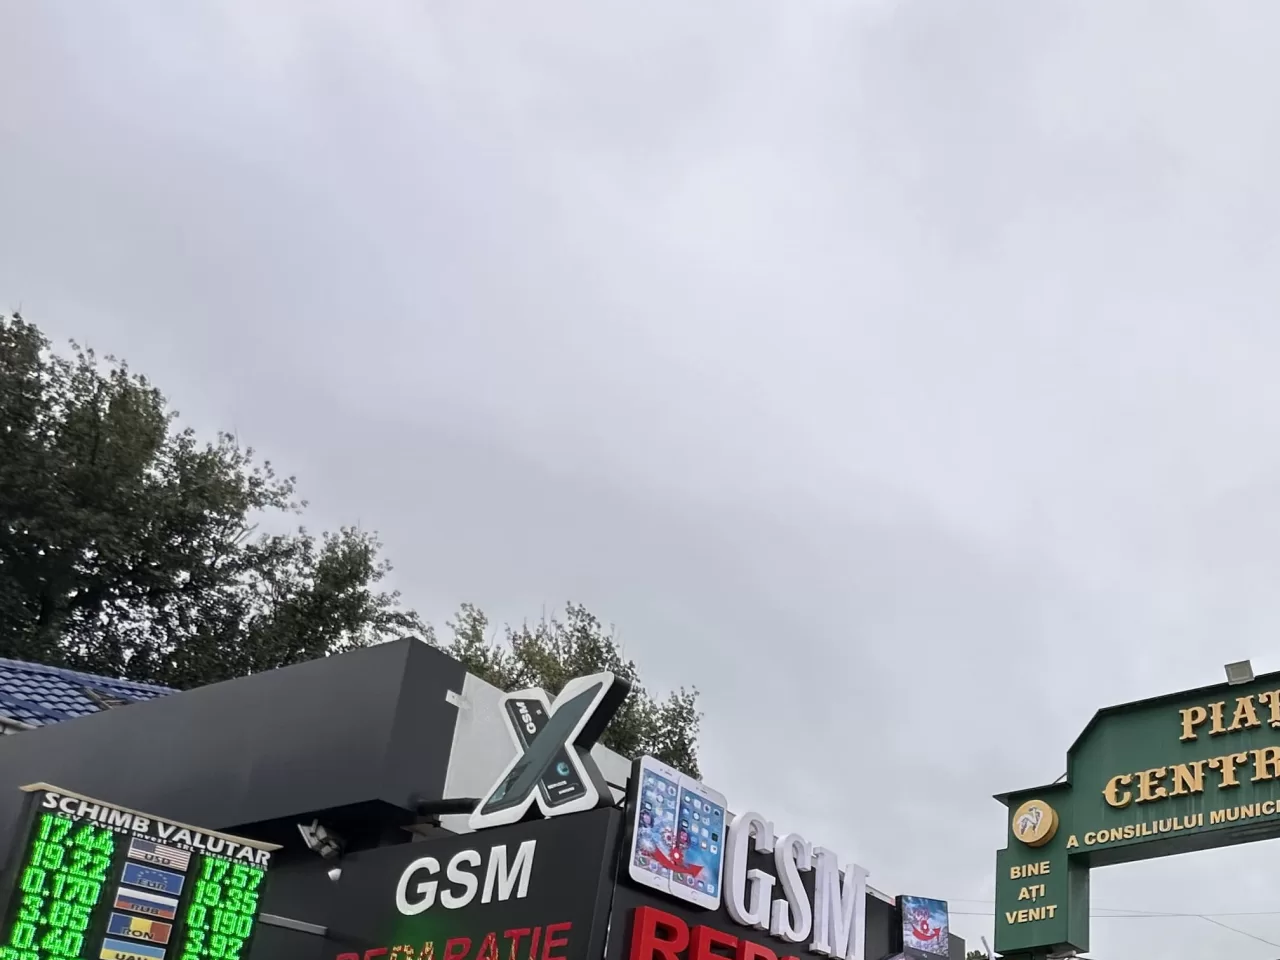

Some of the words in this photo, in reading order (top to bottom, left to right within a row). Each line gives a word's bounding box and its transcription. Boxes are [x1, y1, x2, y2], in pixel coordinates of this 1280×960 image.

[516, 702, 537, 734] GSM
[42, 791, 151, 833] SCHIMB
[156, 821, 272, 866] VALUTAR
[176, 842, 196, 853] SRL
[1066, 834, 1079, 849] A
[1084, 812, 1205, 847] CONSILIULUI
[38, 813, 115, 856] 17.44
[144, 853, 171, 865] USD
[202, 856, 265, 890] 17.57
[1010, 861, 1050, 880] BINE
[32, 840, 111, 882] 19.22
[194, 880, 259, 915] 19.35
[396, 839, 537, 916] GSM
[1018, 884, 1046, 902] AȚI
[19, 894, 92, 931] 3.85
[122, 927, 155, 940] RON
[20, 866, 102, 906] 0.170
[130, 903, 160, 915] RUB
[186, 904, 254, 939] 0.190
[1005, 905, 1058, 924] VENIT
[11, 920, 85, 958] 0.40
